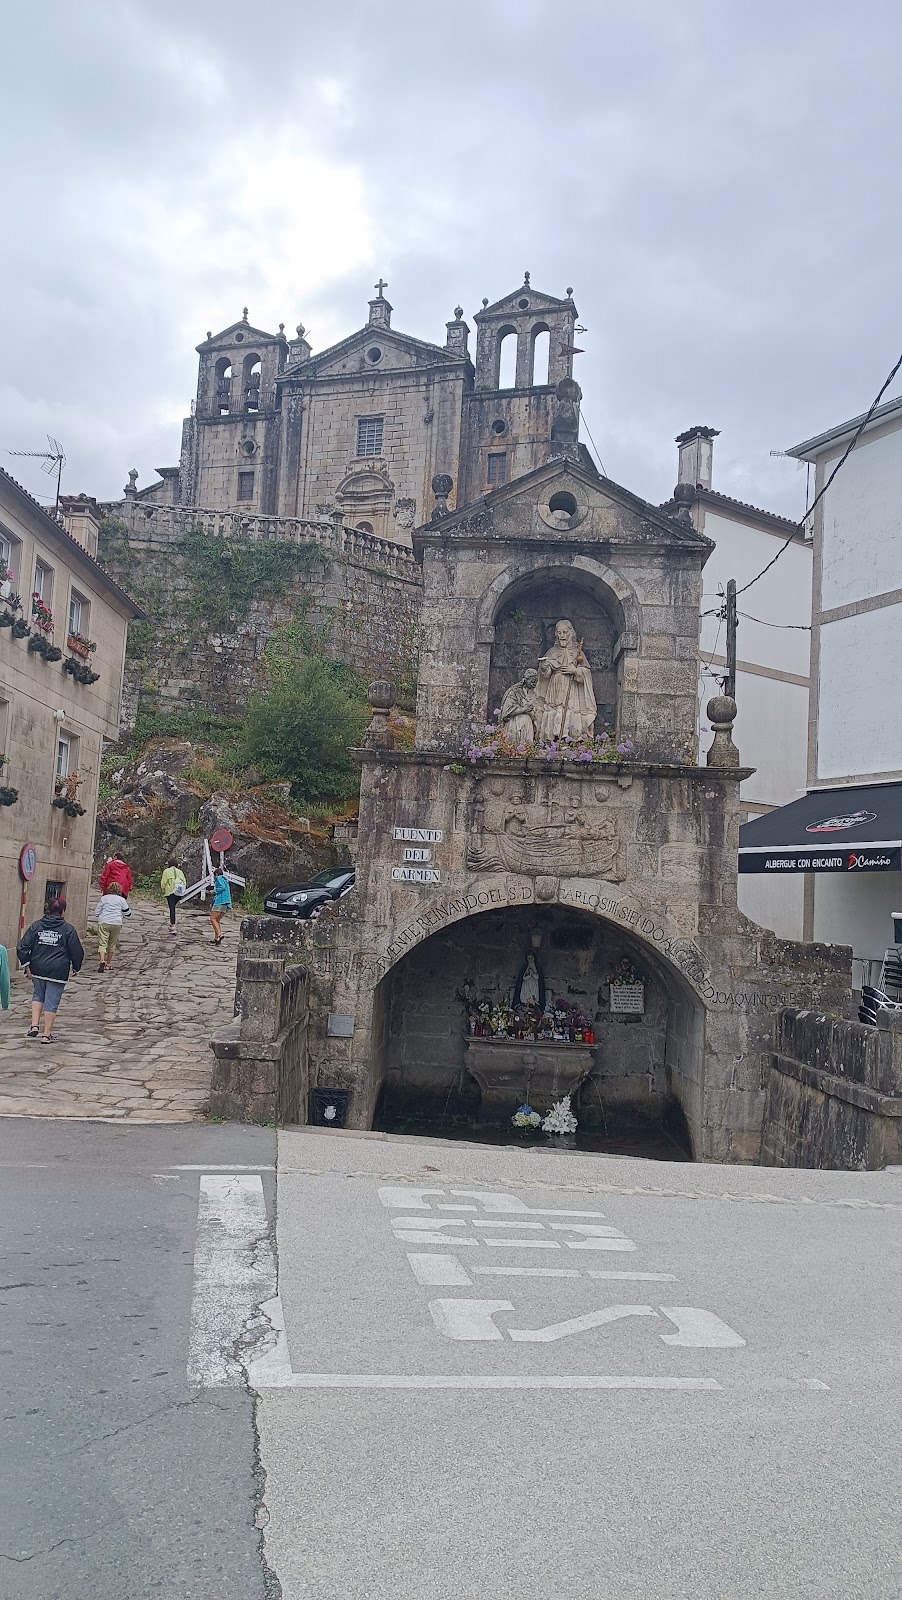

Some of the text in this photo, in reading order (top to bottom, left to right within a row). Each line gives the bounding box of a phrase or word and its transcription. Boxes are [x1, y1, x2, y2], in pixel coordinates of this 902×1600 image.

[394, 828, 442, 842] FUENTE
[405, 849, 428, 860] DEL
[765, 859, 796, 869] ALBERGUE
[797, 858, 811, 868] CON
[812, 857, 843, 868] ENCANTO
[392, 868, 440, 881] CARMEN
[377, 1187, 746, 1347] STOP
